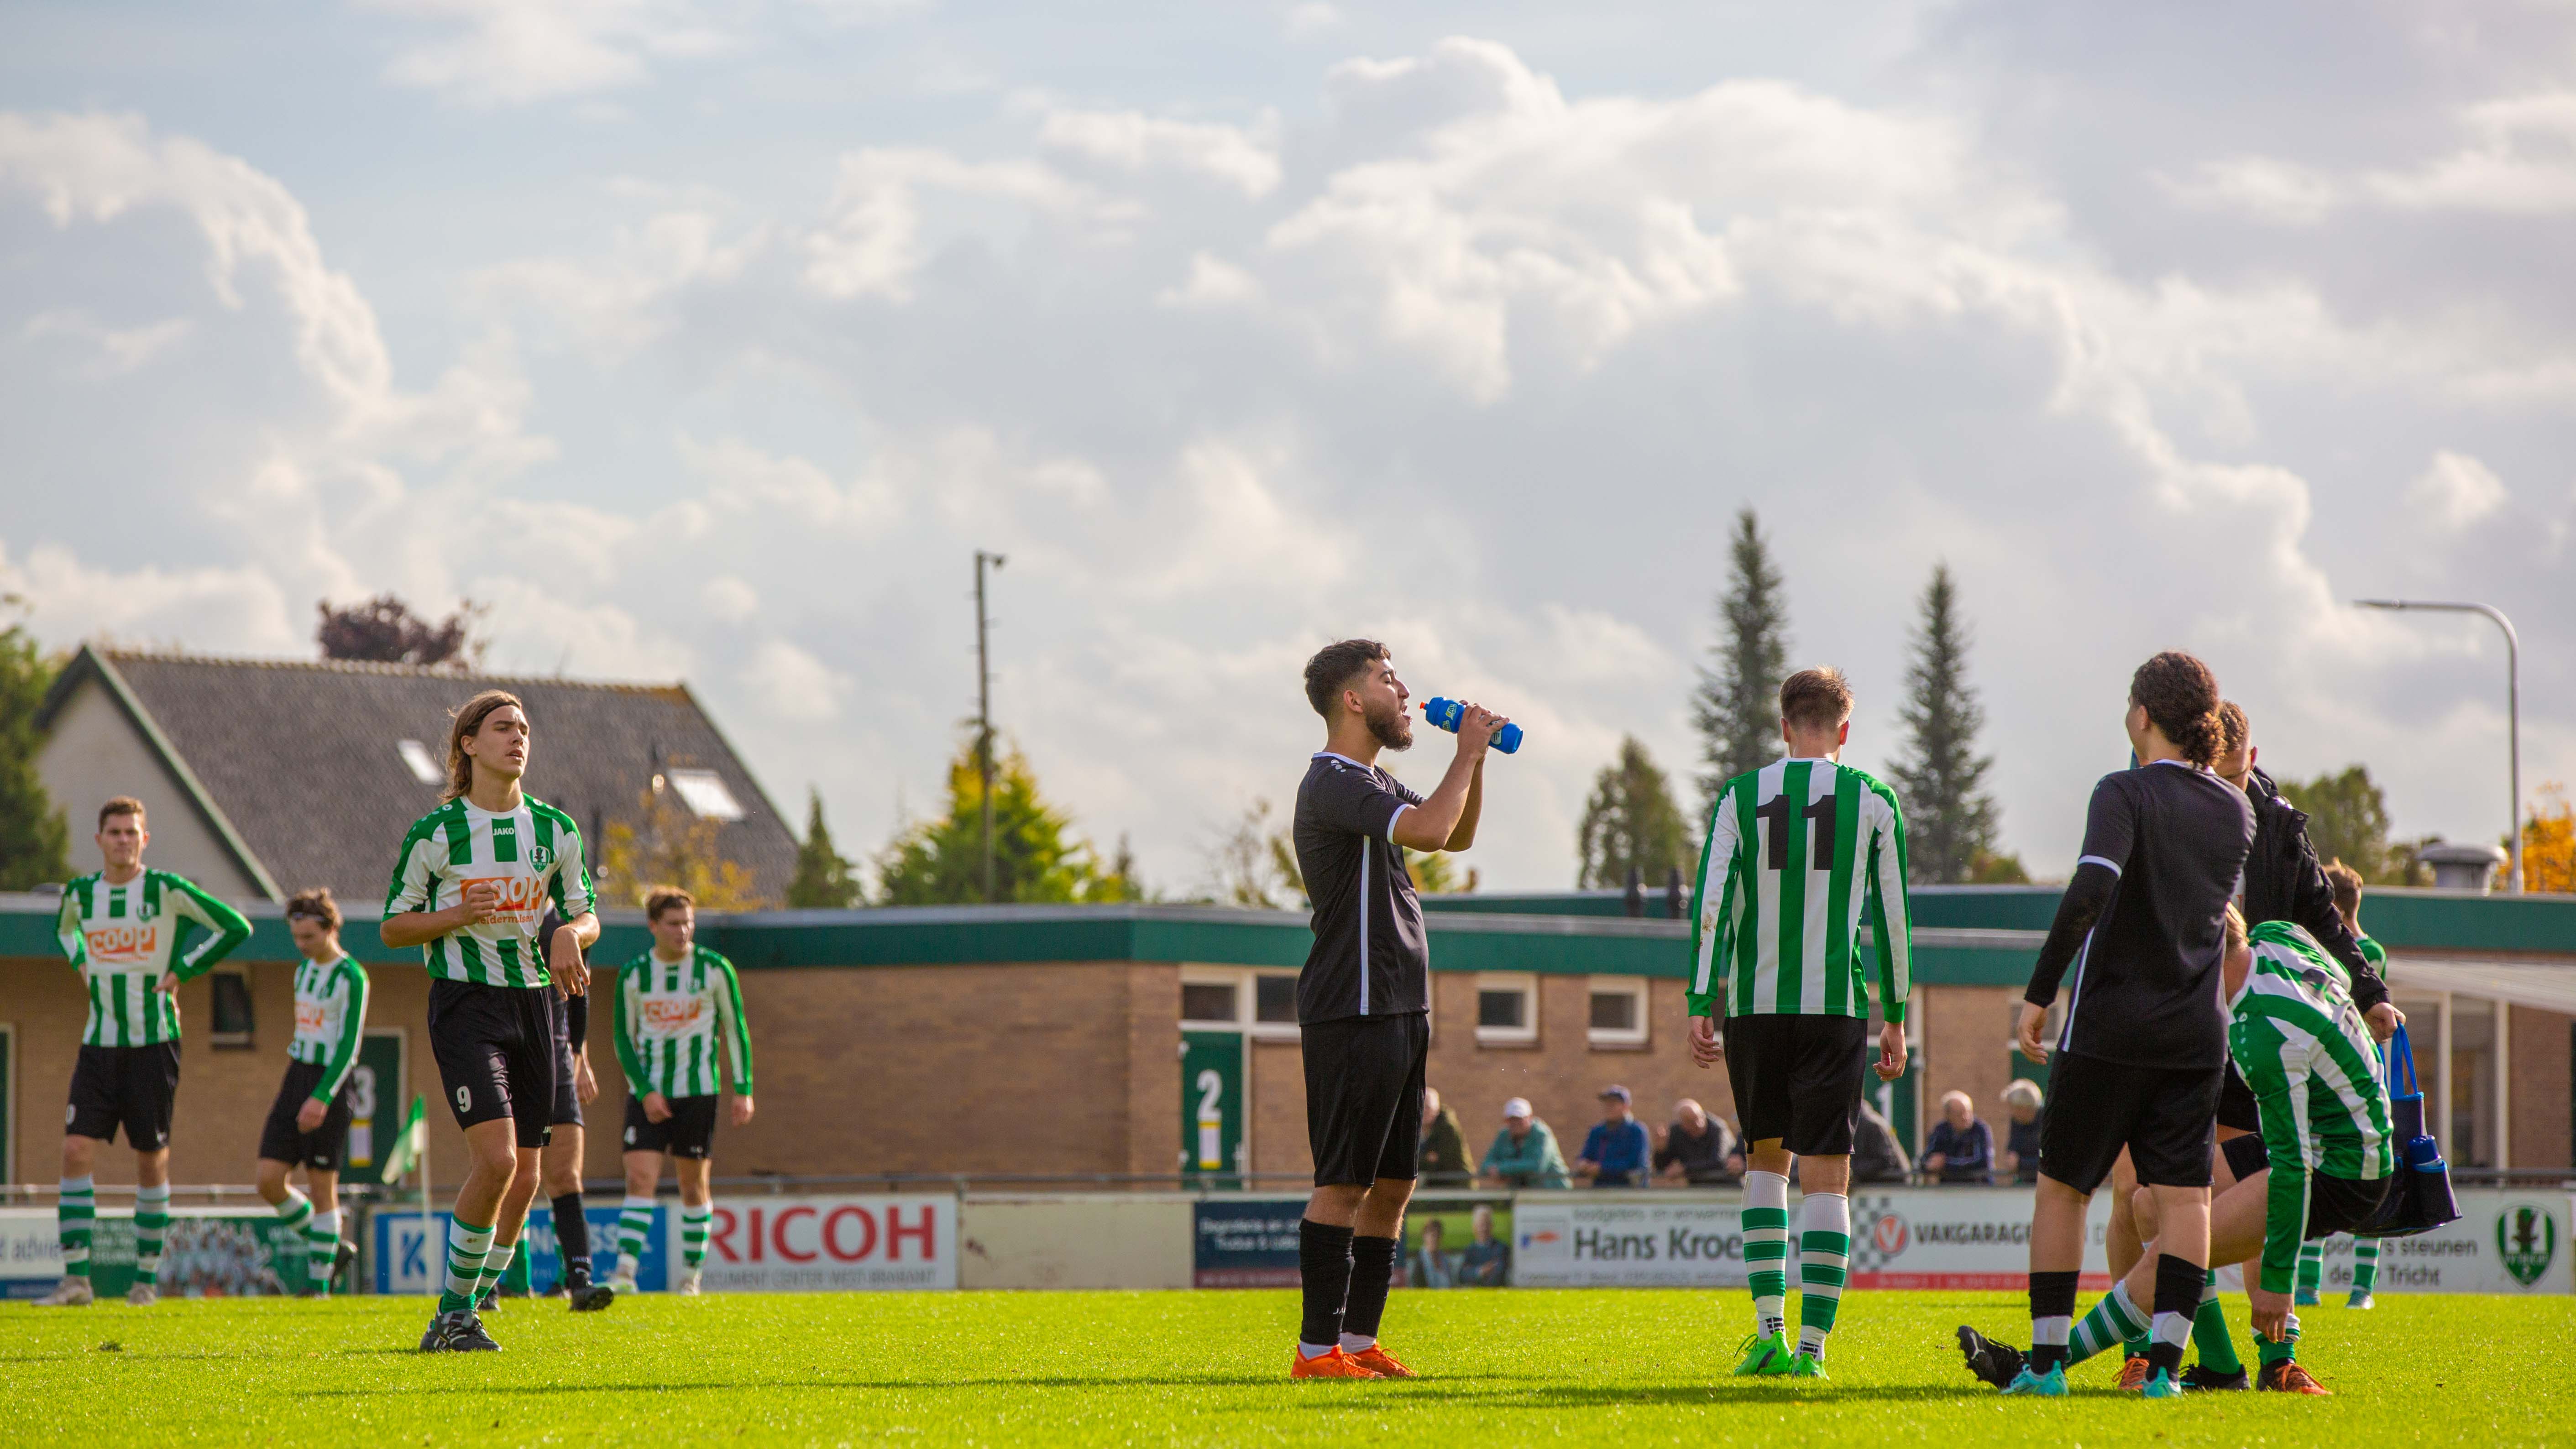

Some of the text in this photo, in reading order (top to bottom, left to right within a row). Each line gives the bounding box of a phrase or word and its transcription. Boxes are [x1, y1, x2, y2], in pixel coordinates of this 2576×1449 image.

[493, 827, 515, 836] JAKO
[1756, 794, 1837, 870] 11
[467, 876, 545, 910] oop
[91, 927, 151, 955] coop
[649, 999, 696, 1021] coop
[457, 1085, 471, 1113] 9
[1196, 1069, 1223, 1120] 2
[709, 1204, 935, 1262] RICOH
[1573, 1228, 1657, 1261] Hans
[2400, 1237, 2478, 1255] steunen
[2387, 1263, 2441, 1286] Tricht
